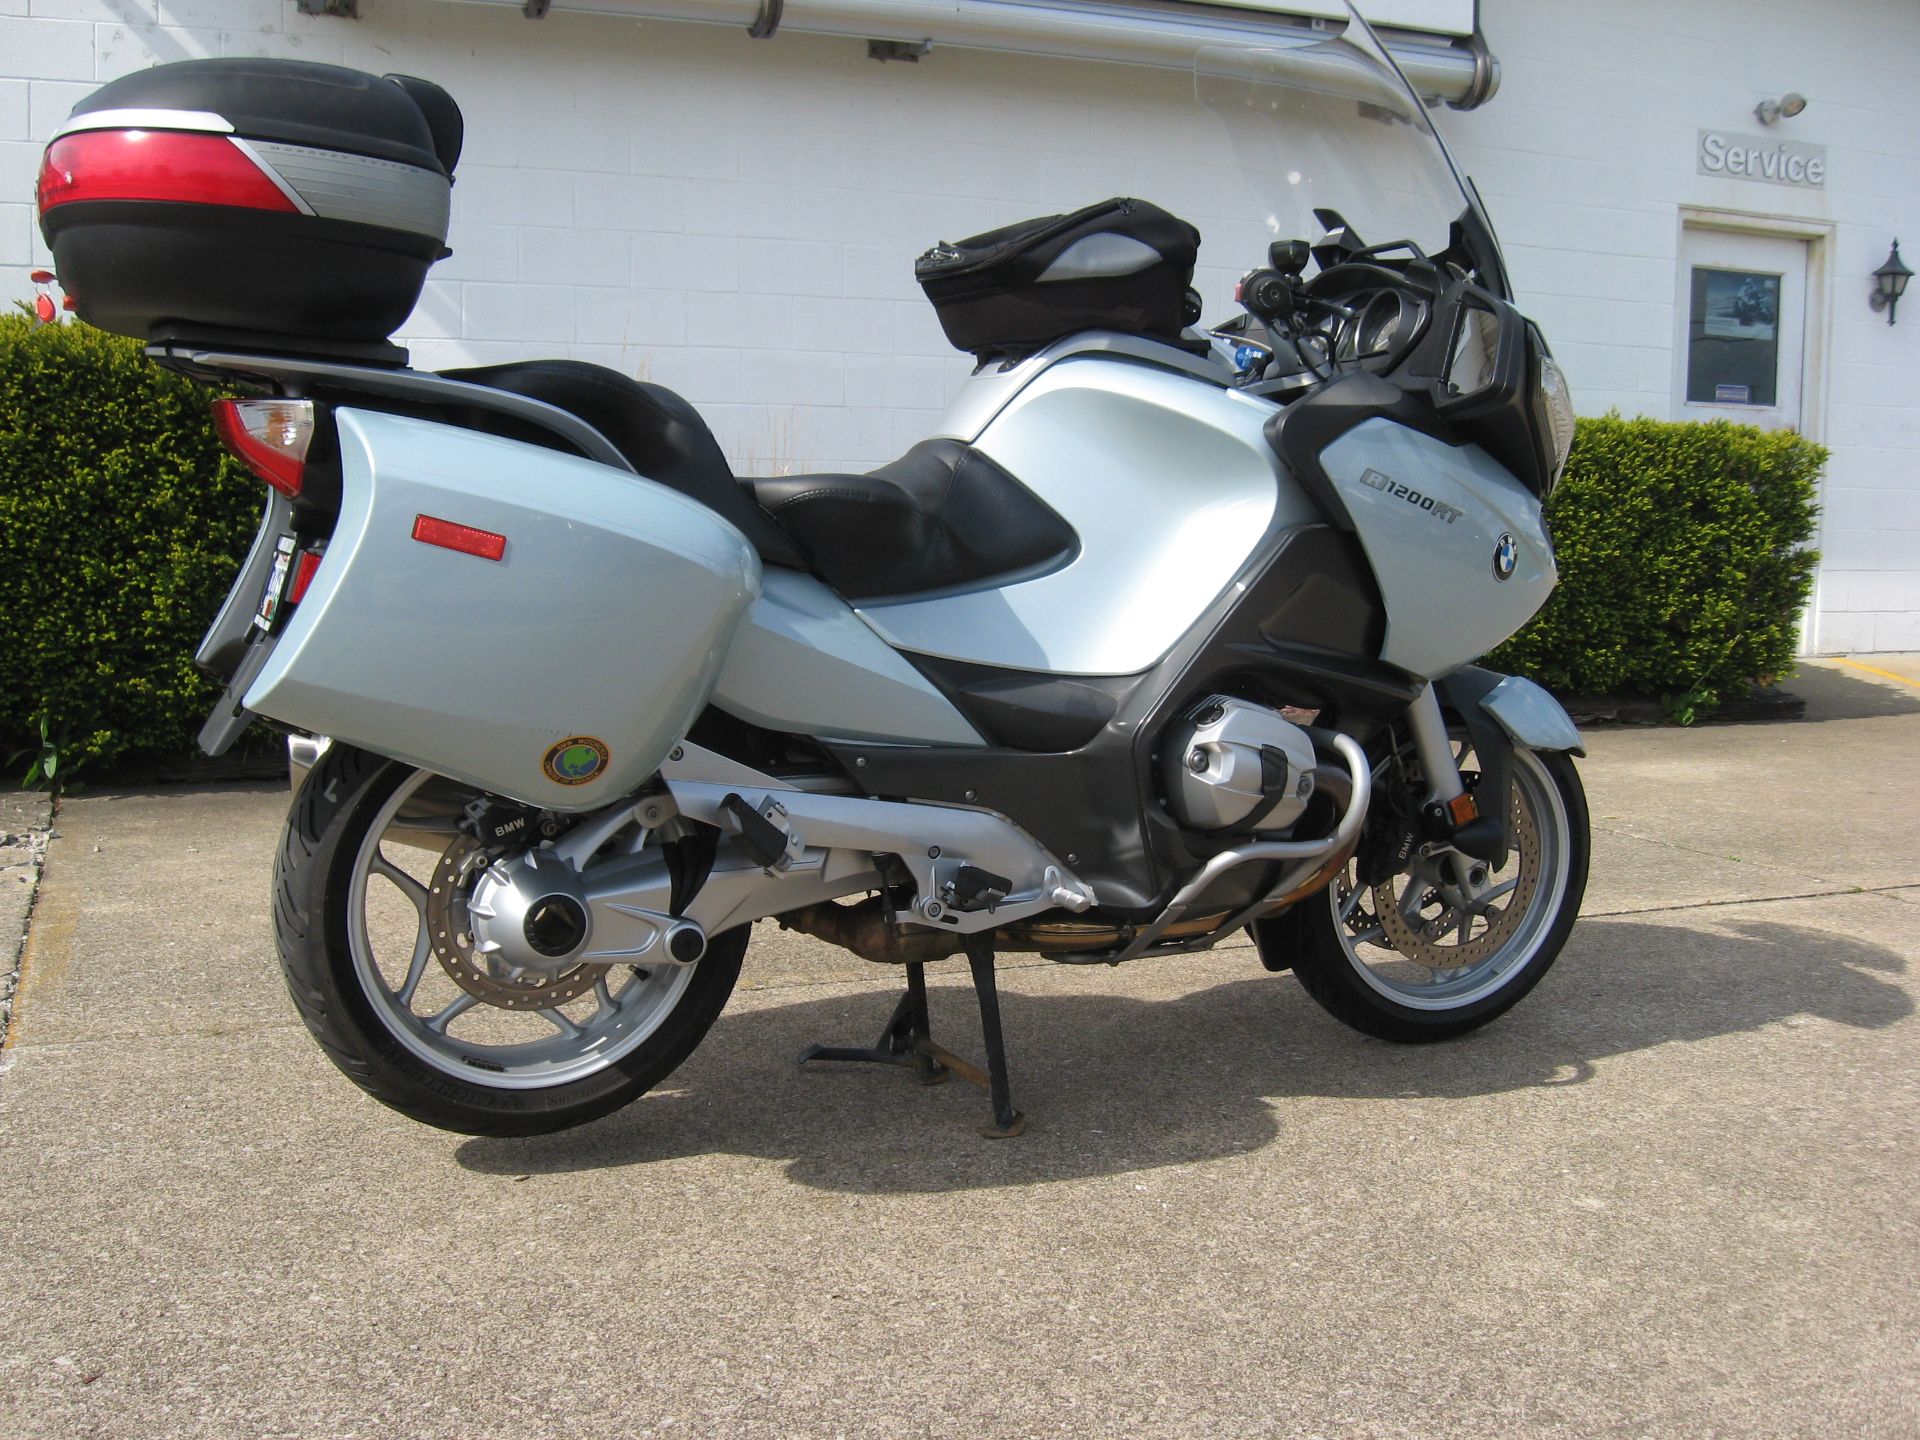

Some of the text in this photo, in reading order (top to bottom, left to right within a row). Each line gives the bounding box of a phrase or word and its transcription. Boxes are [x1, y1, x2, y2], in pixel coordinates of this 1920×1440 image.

[1702, 133, 1824, 184] Service
[495, 817, 525, 837] BMW
[1398, 832, 1415, 860] BMW
